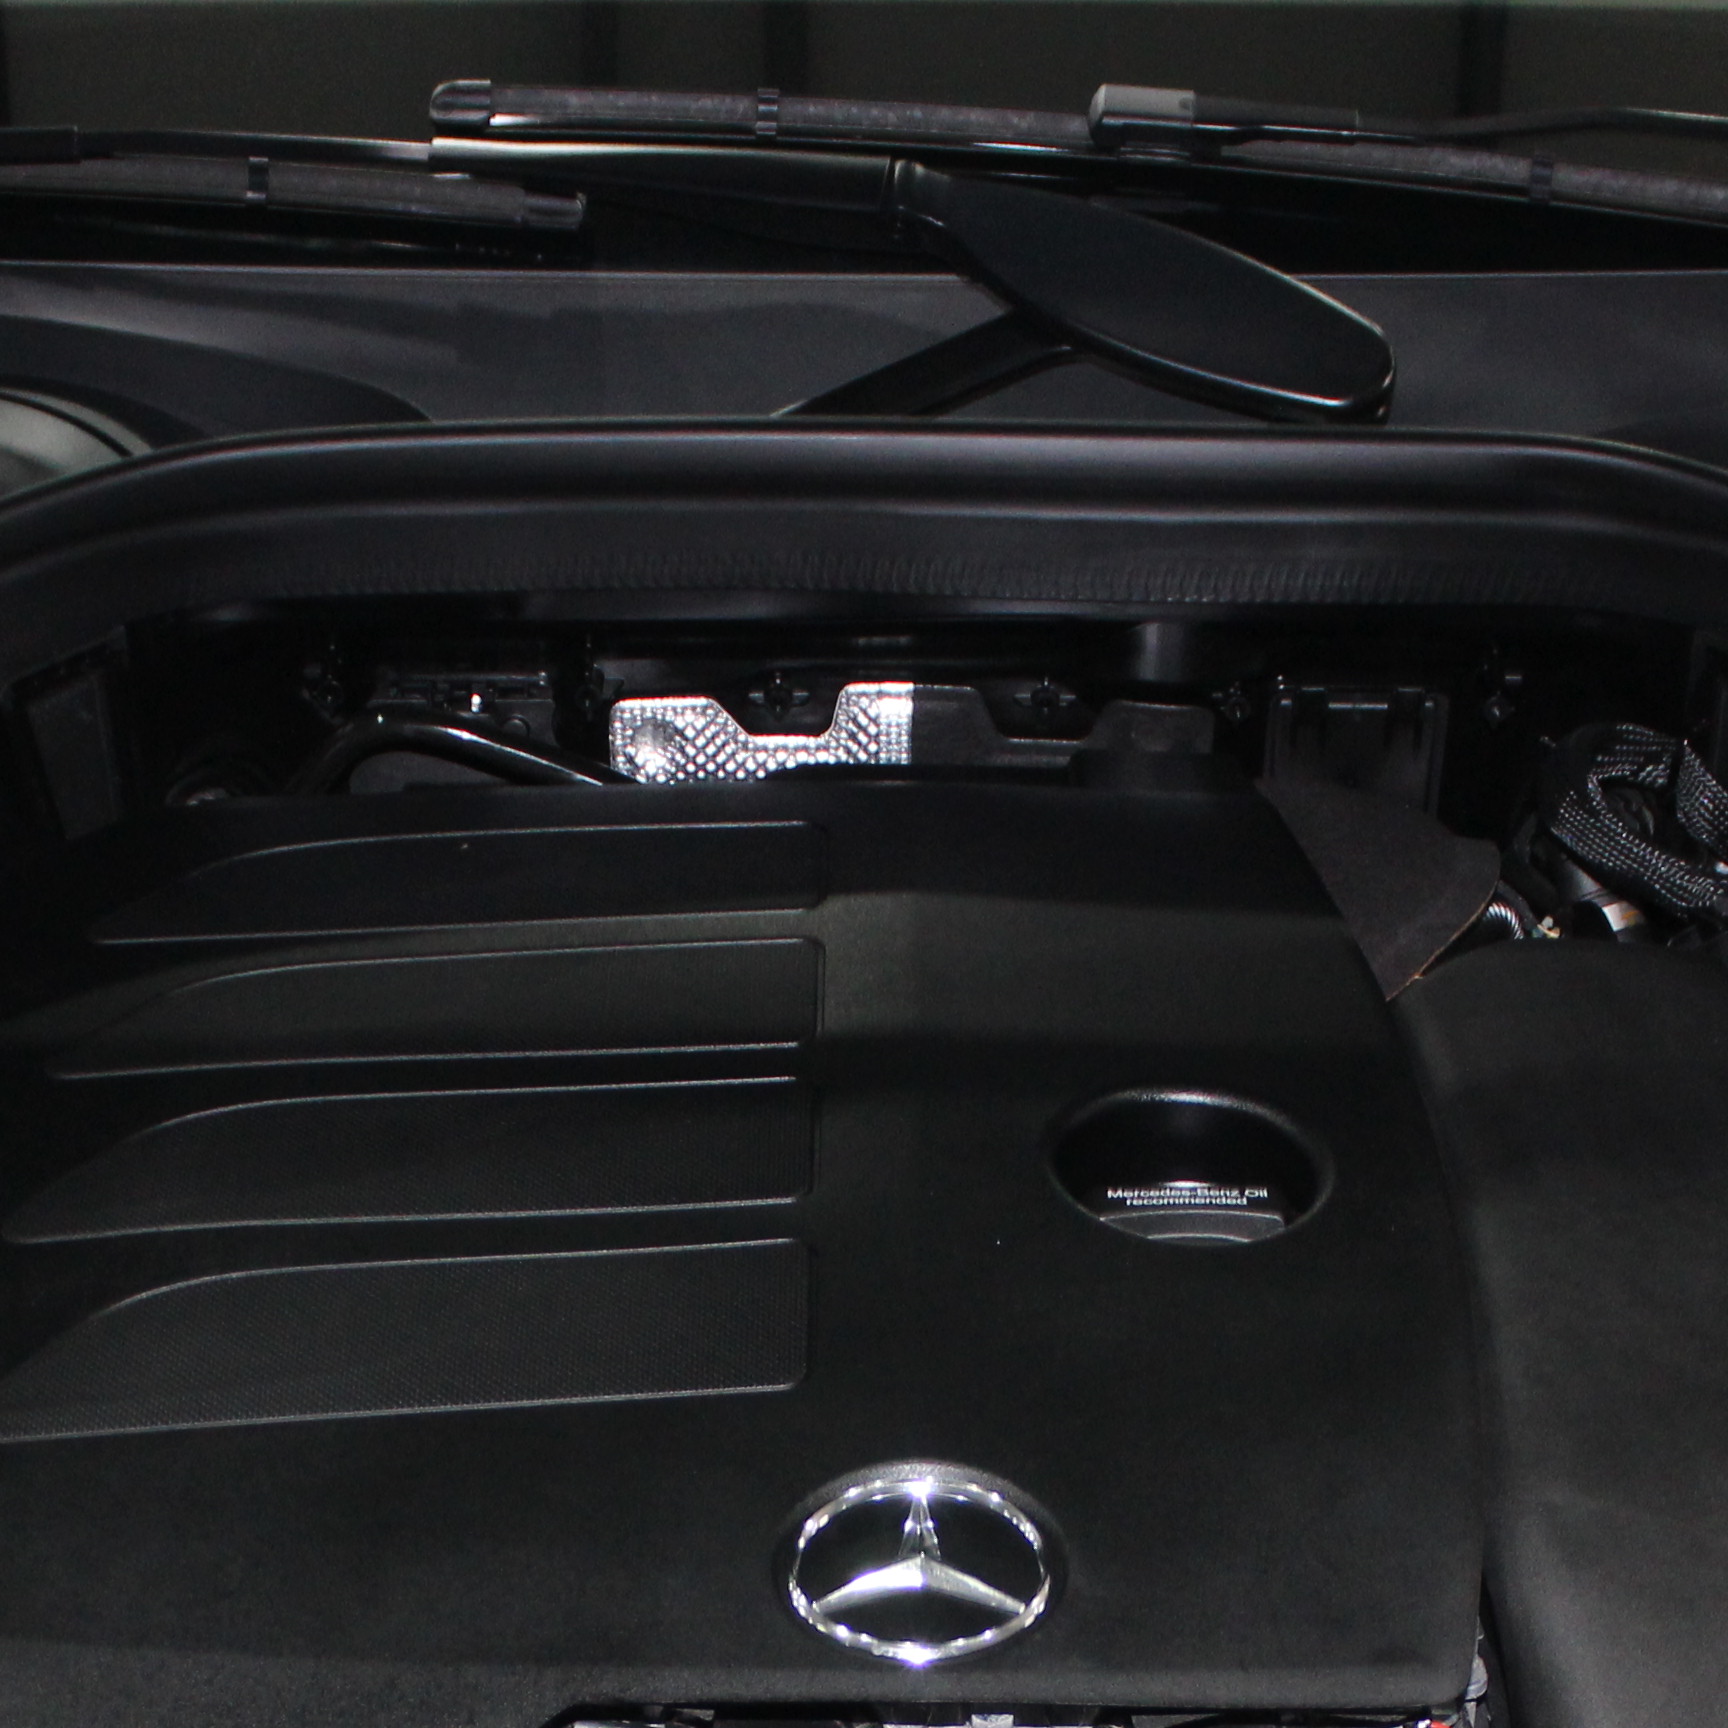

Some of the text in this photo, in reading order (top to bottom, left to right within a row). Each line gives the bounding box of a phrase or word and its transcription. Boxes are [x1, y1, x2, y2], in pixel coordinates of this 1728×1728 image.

[1106, 1187, 1269, 1199] Mercedes-Benz Oil
[1125, 1196, 1248, 1206] recommended
